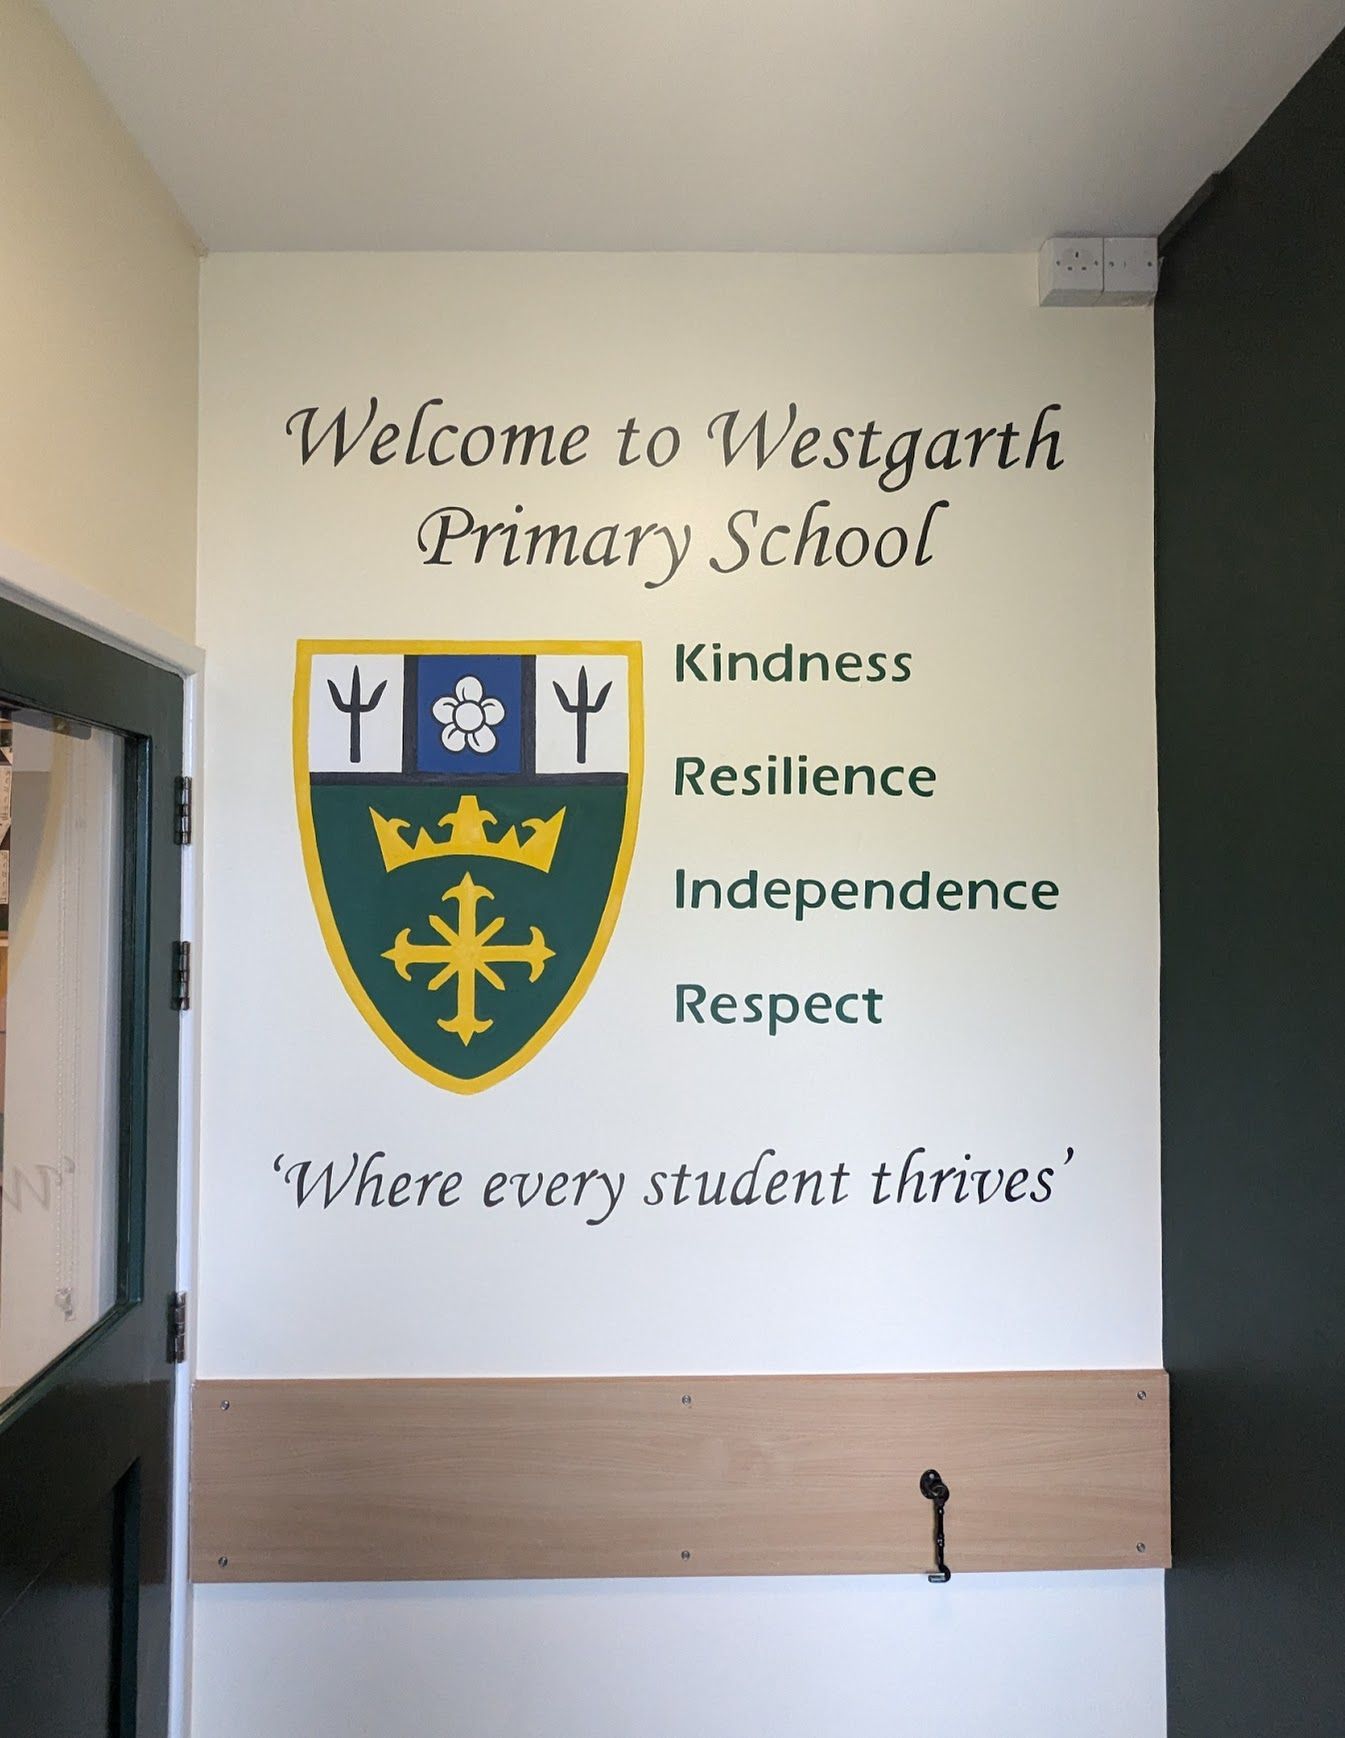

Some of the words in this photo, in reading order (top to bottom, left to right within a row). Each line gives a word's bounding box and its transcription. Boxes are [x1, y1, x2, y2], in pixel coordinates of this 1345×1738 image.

[286, 397, 590, 468] Welcome
[617, 416, 681, 468] to
[707, 402, 1065, 493] Westgarth
[418, 504, 692, 590] Primary
[709, 499, 950, 574] School
[675, 642, 913, 683] Kindness
[675, 754, 937, 798] Resilience
[675, 868, 1060, 922] Independence
[675, 983, 884, 1037] Respect
[273, 1151, 463, 1210] ‘Where
[482, 1168, 626, 1227] every
[642, 1148, 851, 1208] student
[871, 1146, 1076, 1206] thrives’
